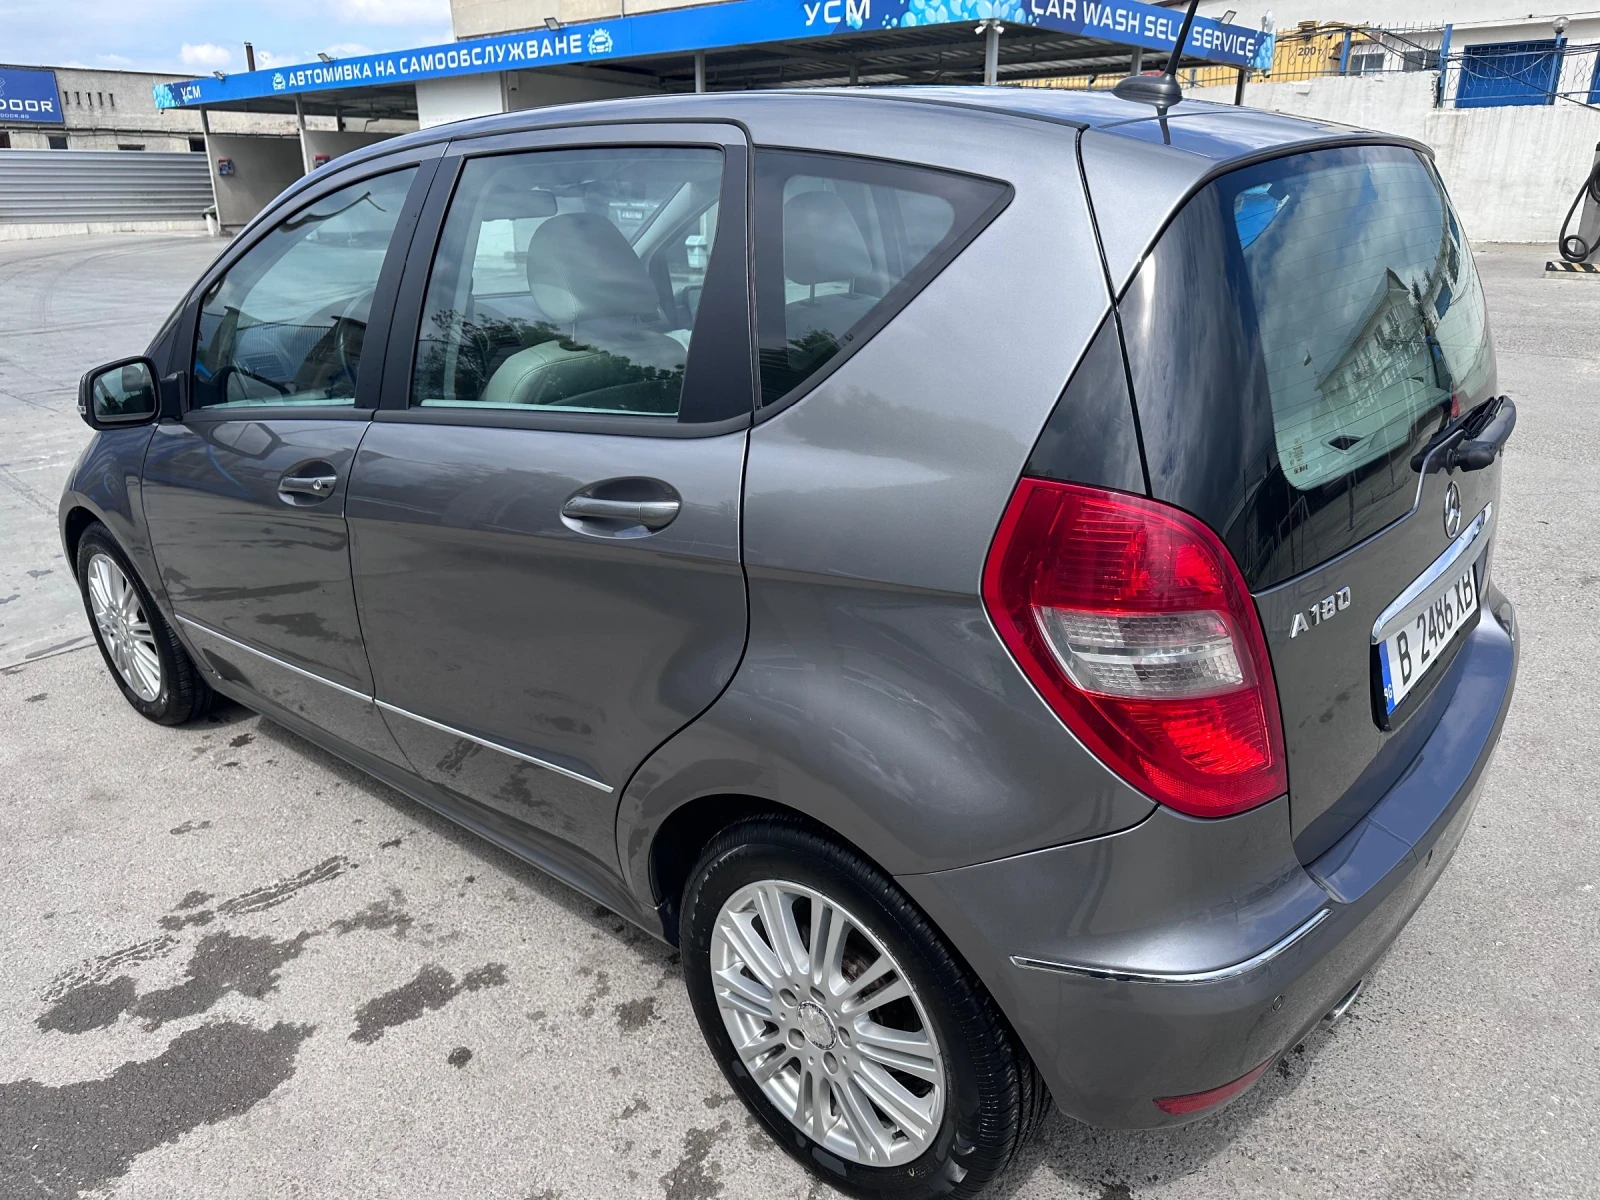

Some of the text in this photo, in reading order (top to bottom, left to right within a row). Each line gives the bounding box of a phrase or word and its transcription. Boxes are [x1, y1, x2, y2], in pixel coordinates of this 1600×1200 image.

[1031, 0, 1255, 57] CAR WASH SEL SERVICE
[288, 34, 582, 87] АВТОМИВКА НА САМООБСЛУЖВАНЕ
[1396, 570, 1474, 687] B 2486 XB
